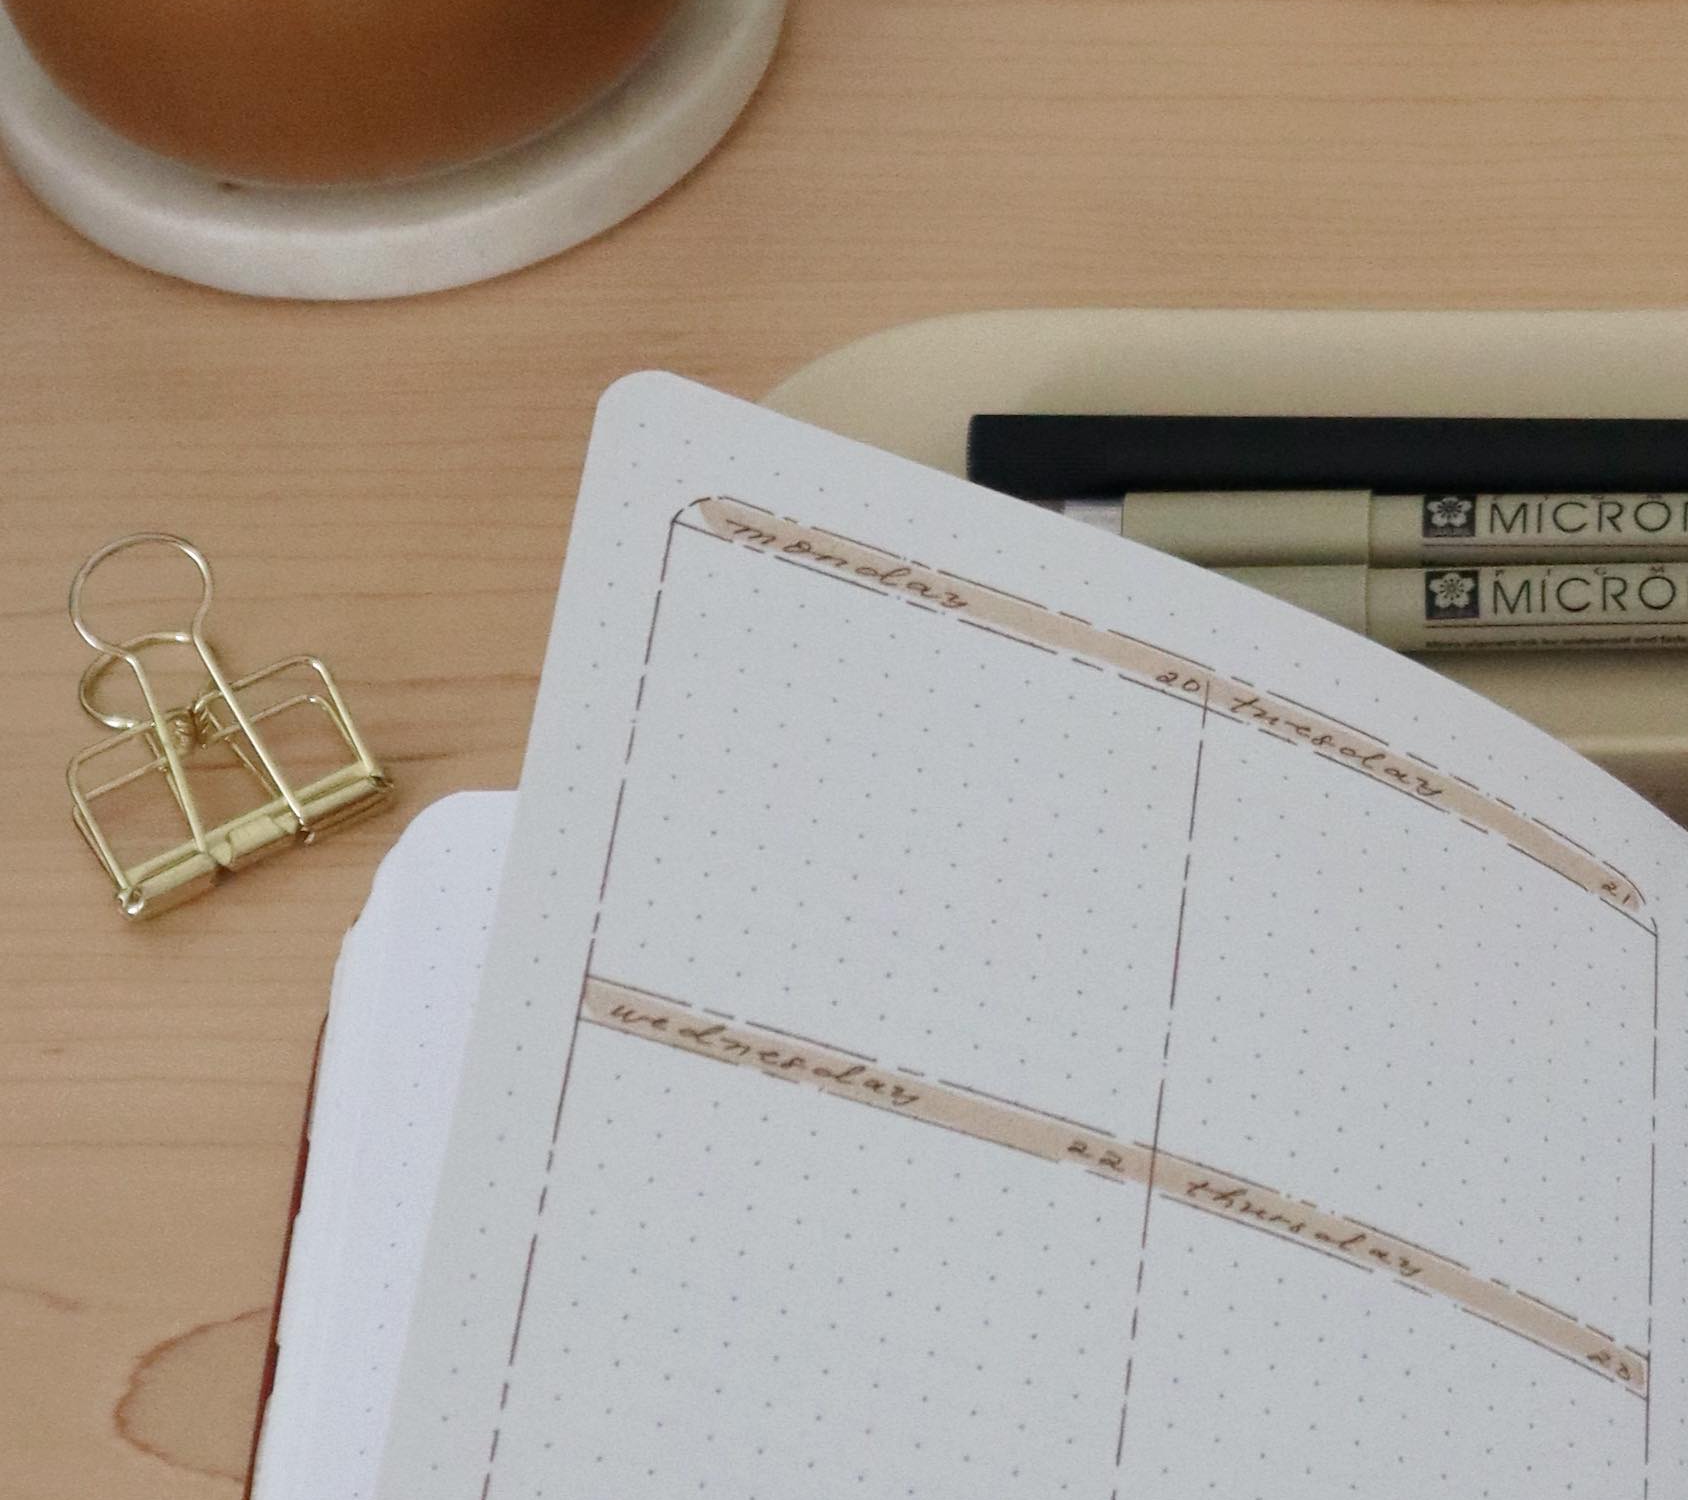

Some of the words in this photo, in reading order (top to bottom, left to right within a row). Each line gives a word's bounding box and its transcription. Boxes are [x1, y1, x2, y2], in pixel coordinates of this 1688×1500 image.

[726, 519, 967, 610] monday
[1156, 671, 1201, 694] 20
[1227, 697, 1443, 799] tuesday
[610, 1005, 921, 1107] wednesday
[1067, 1139, 1126, 1172] 22
[1184, 1180, 1424, 1277] thursday
